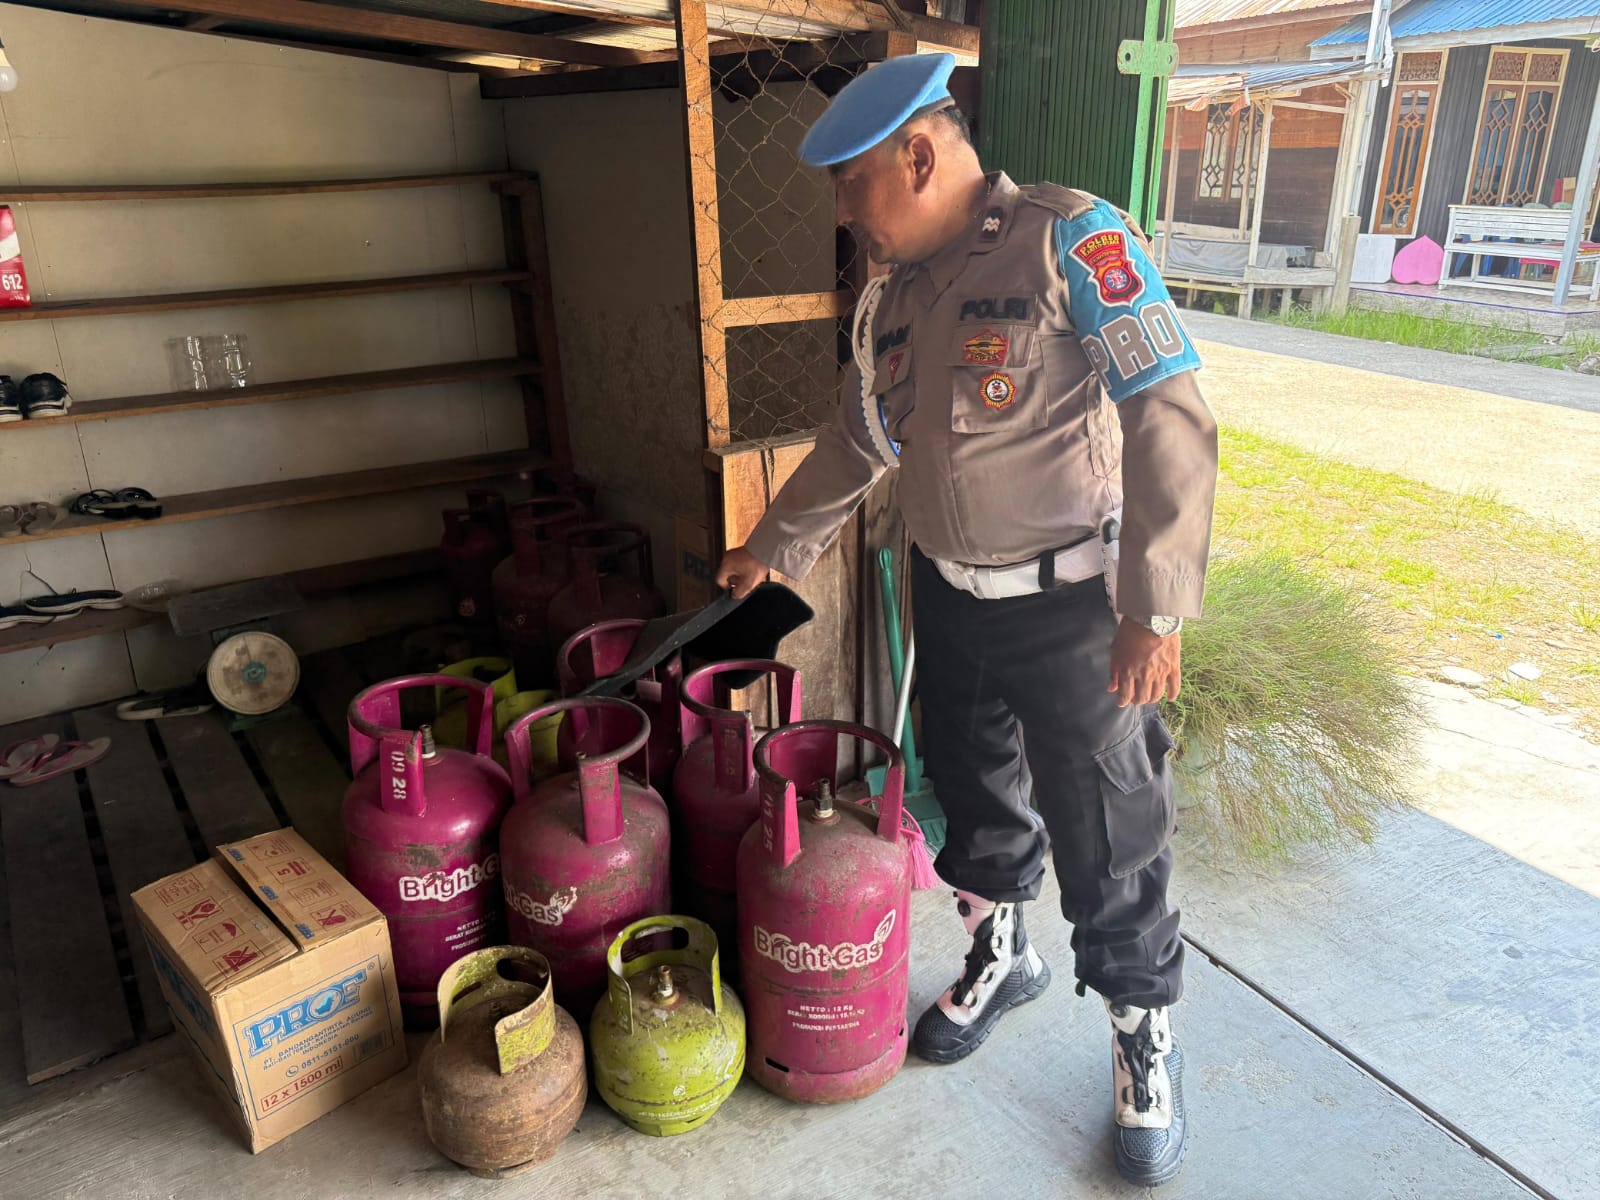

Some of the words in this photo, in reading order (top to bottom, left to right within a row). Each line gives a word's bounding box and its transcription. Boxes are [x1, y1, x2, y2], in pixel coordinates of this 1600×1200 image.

[959, 297, 1028, 321] POLRI
[392, 777, 407, 800] 28
[400, 866, 483, 901] Bright
[755, 926, 829, 972] Bright
[831, 941, 884, 969] Gas
[800, 1004, 826, 1013] NETTO
[263, 1094, 279, 1108] 12
[282, 1088, 290, 1098] x
[293, 1070, 322, 1092] 1500
[325, 1058, 343, 1075] ml
